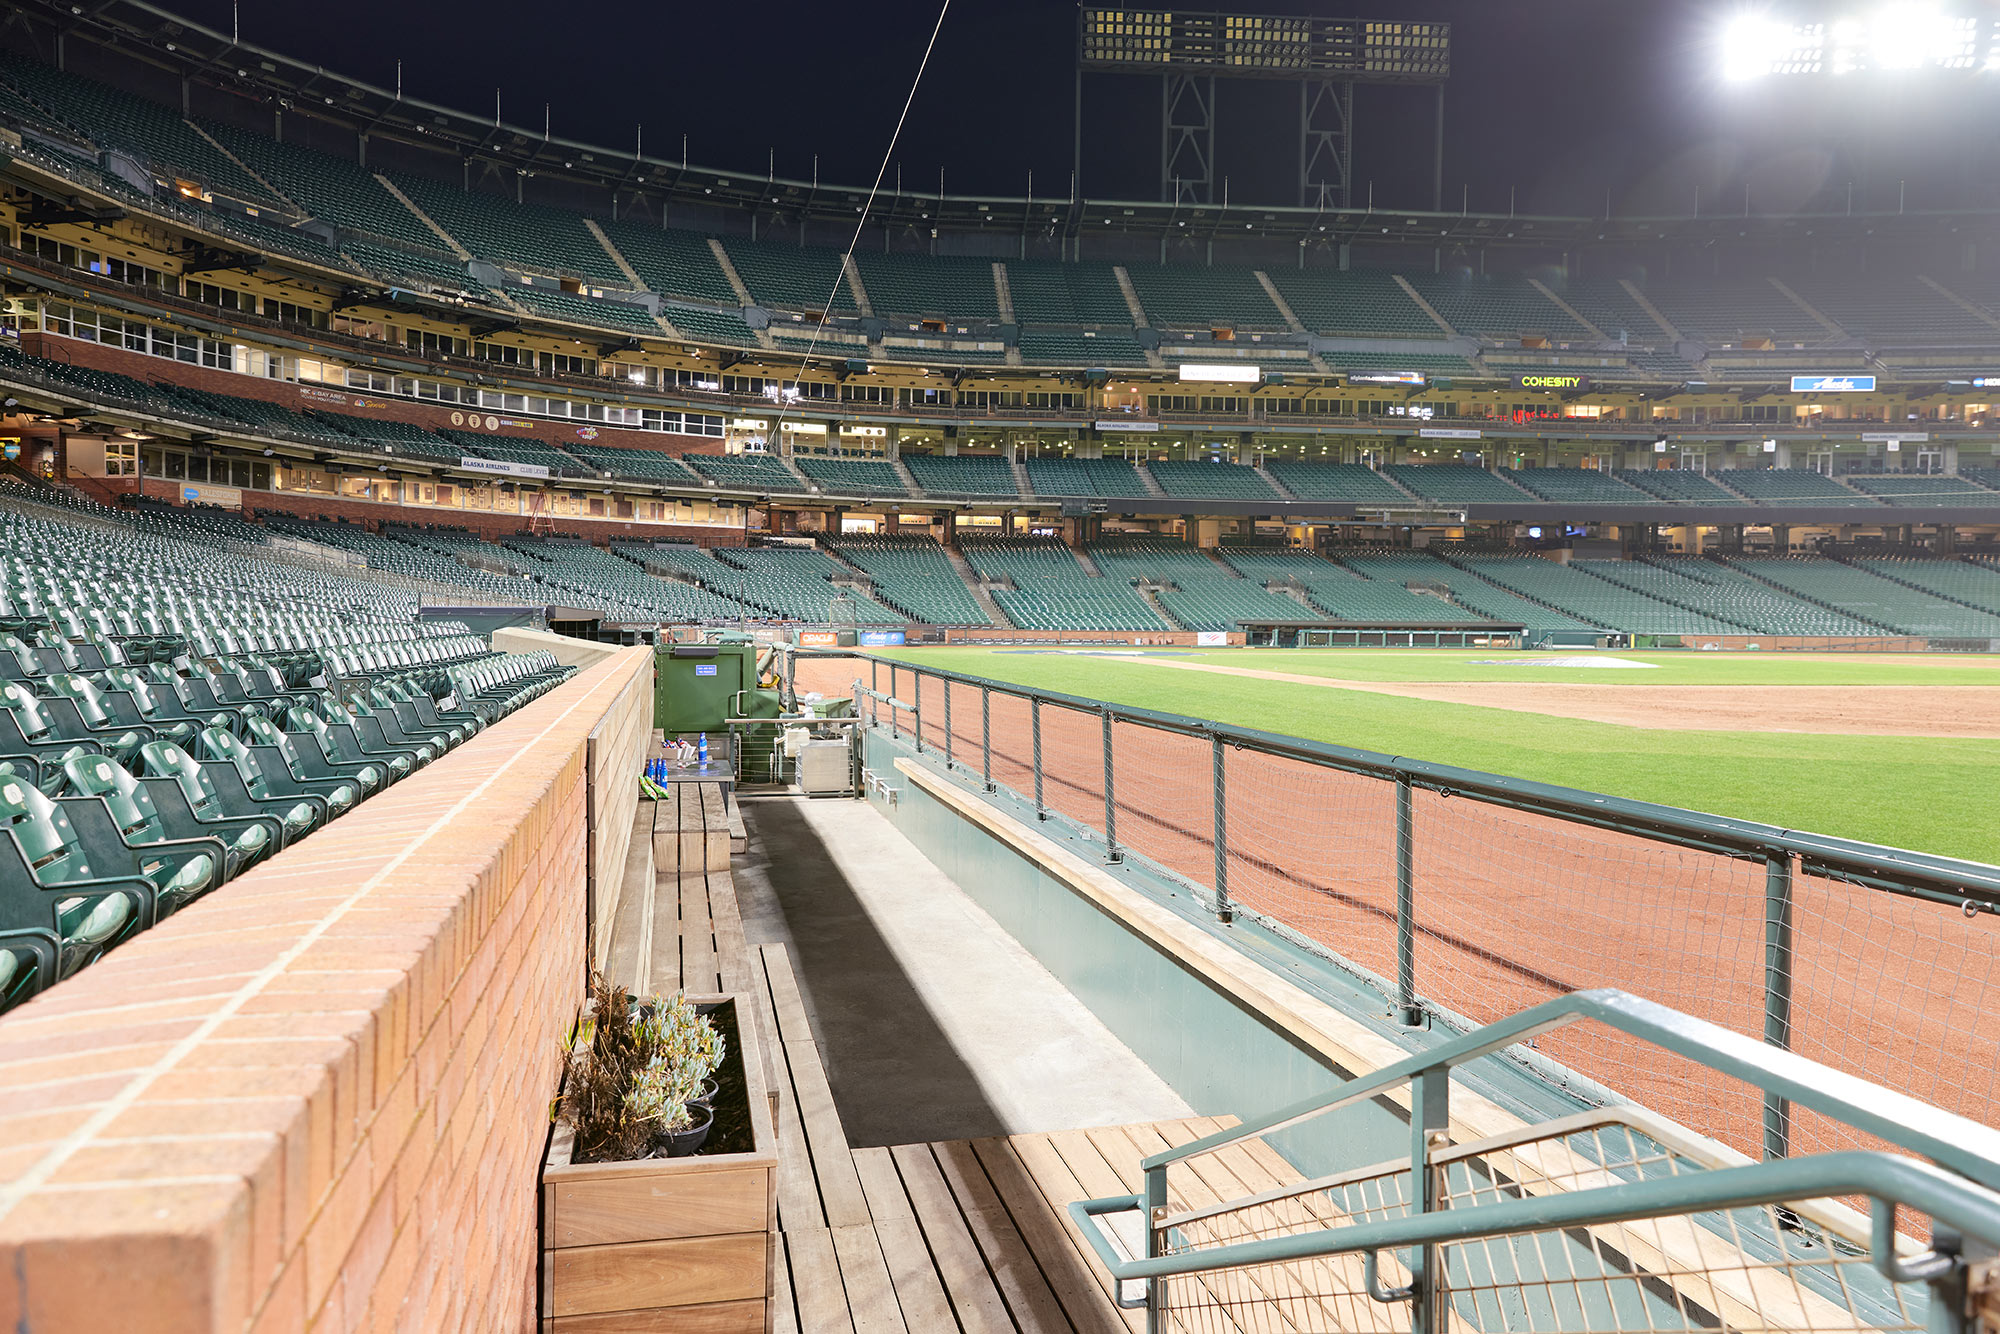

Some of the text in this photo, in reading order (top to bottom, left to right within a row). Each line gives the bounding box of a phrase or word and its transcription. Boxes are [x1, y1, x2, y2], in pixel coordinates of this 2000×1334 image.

[1521, 376, 1581, 387] COHESITY
[364, 400, 386, 409] Sports
[463, 460, 485, 469] ALASKA
[485, 463, 511, 471] AIRLINES
[533, 468, 548, 476] LEVEL
[802, 634, 833, 642] ORACLE
